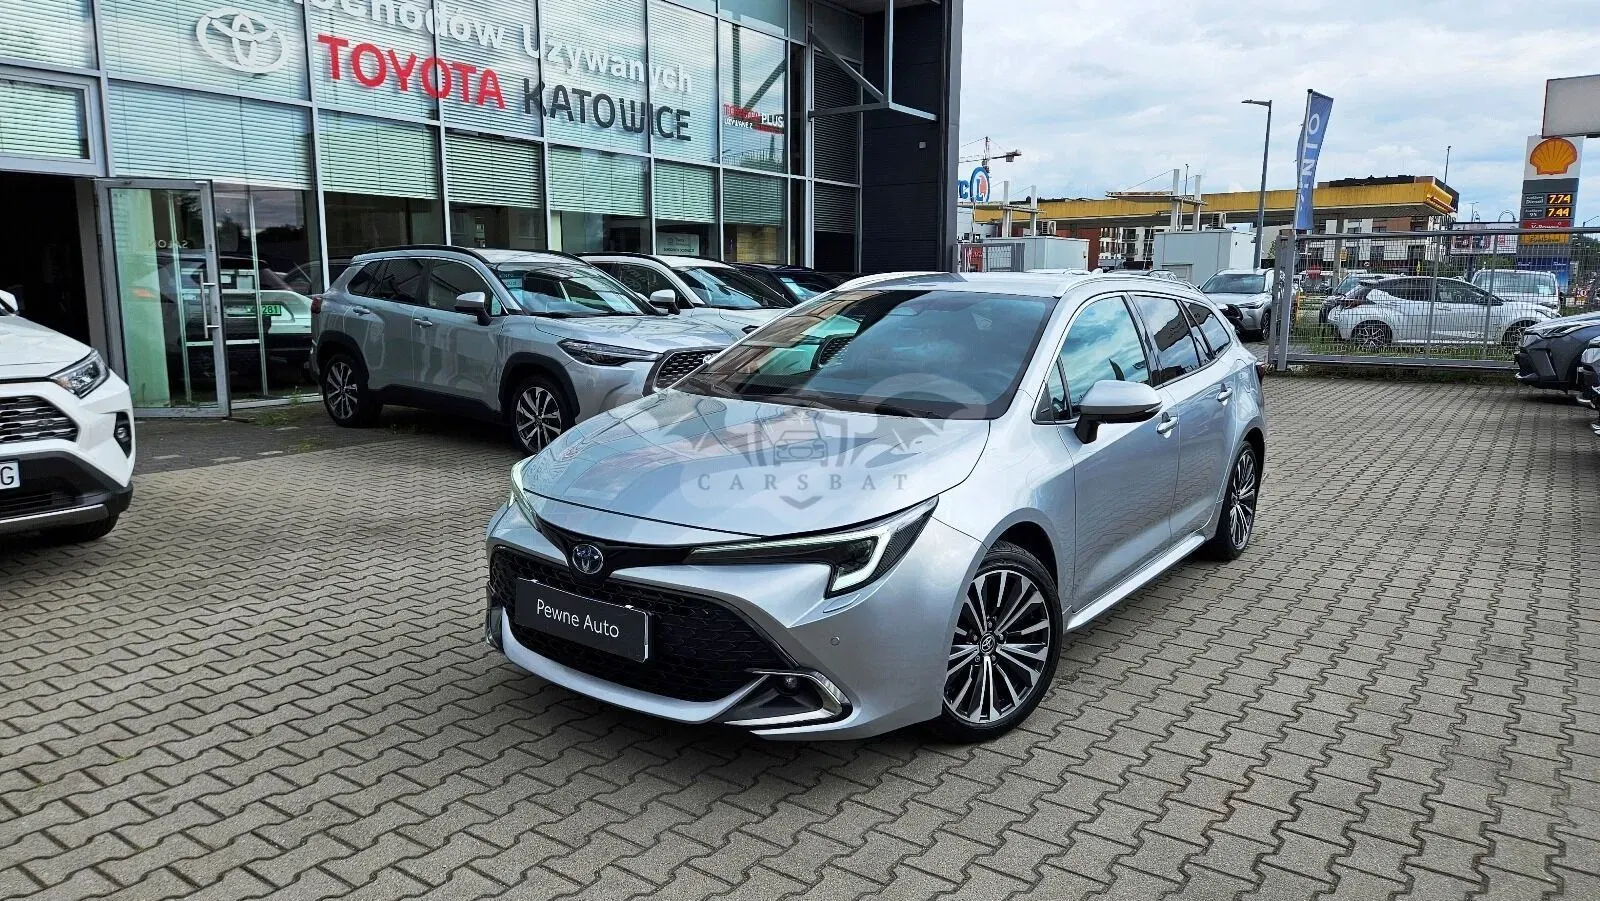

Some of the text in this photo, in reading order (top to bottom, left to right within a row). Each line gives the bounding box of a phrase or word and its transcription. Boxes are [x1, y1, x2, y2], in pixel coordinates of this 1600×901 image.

[317, 33, 692, 142] TOYOTA KATOWICE
[761, 112, 784, 128] PLUS
[1549, 194, 1572, 204] 7.74
[1547, 207, 1570, 217] 7.44
[0, 466, 15, 486] G
[536, 598, 619, 638] Pewne Auto
